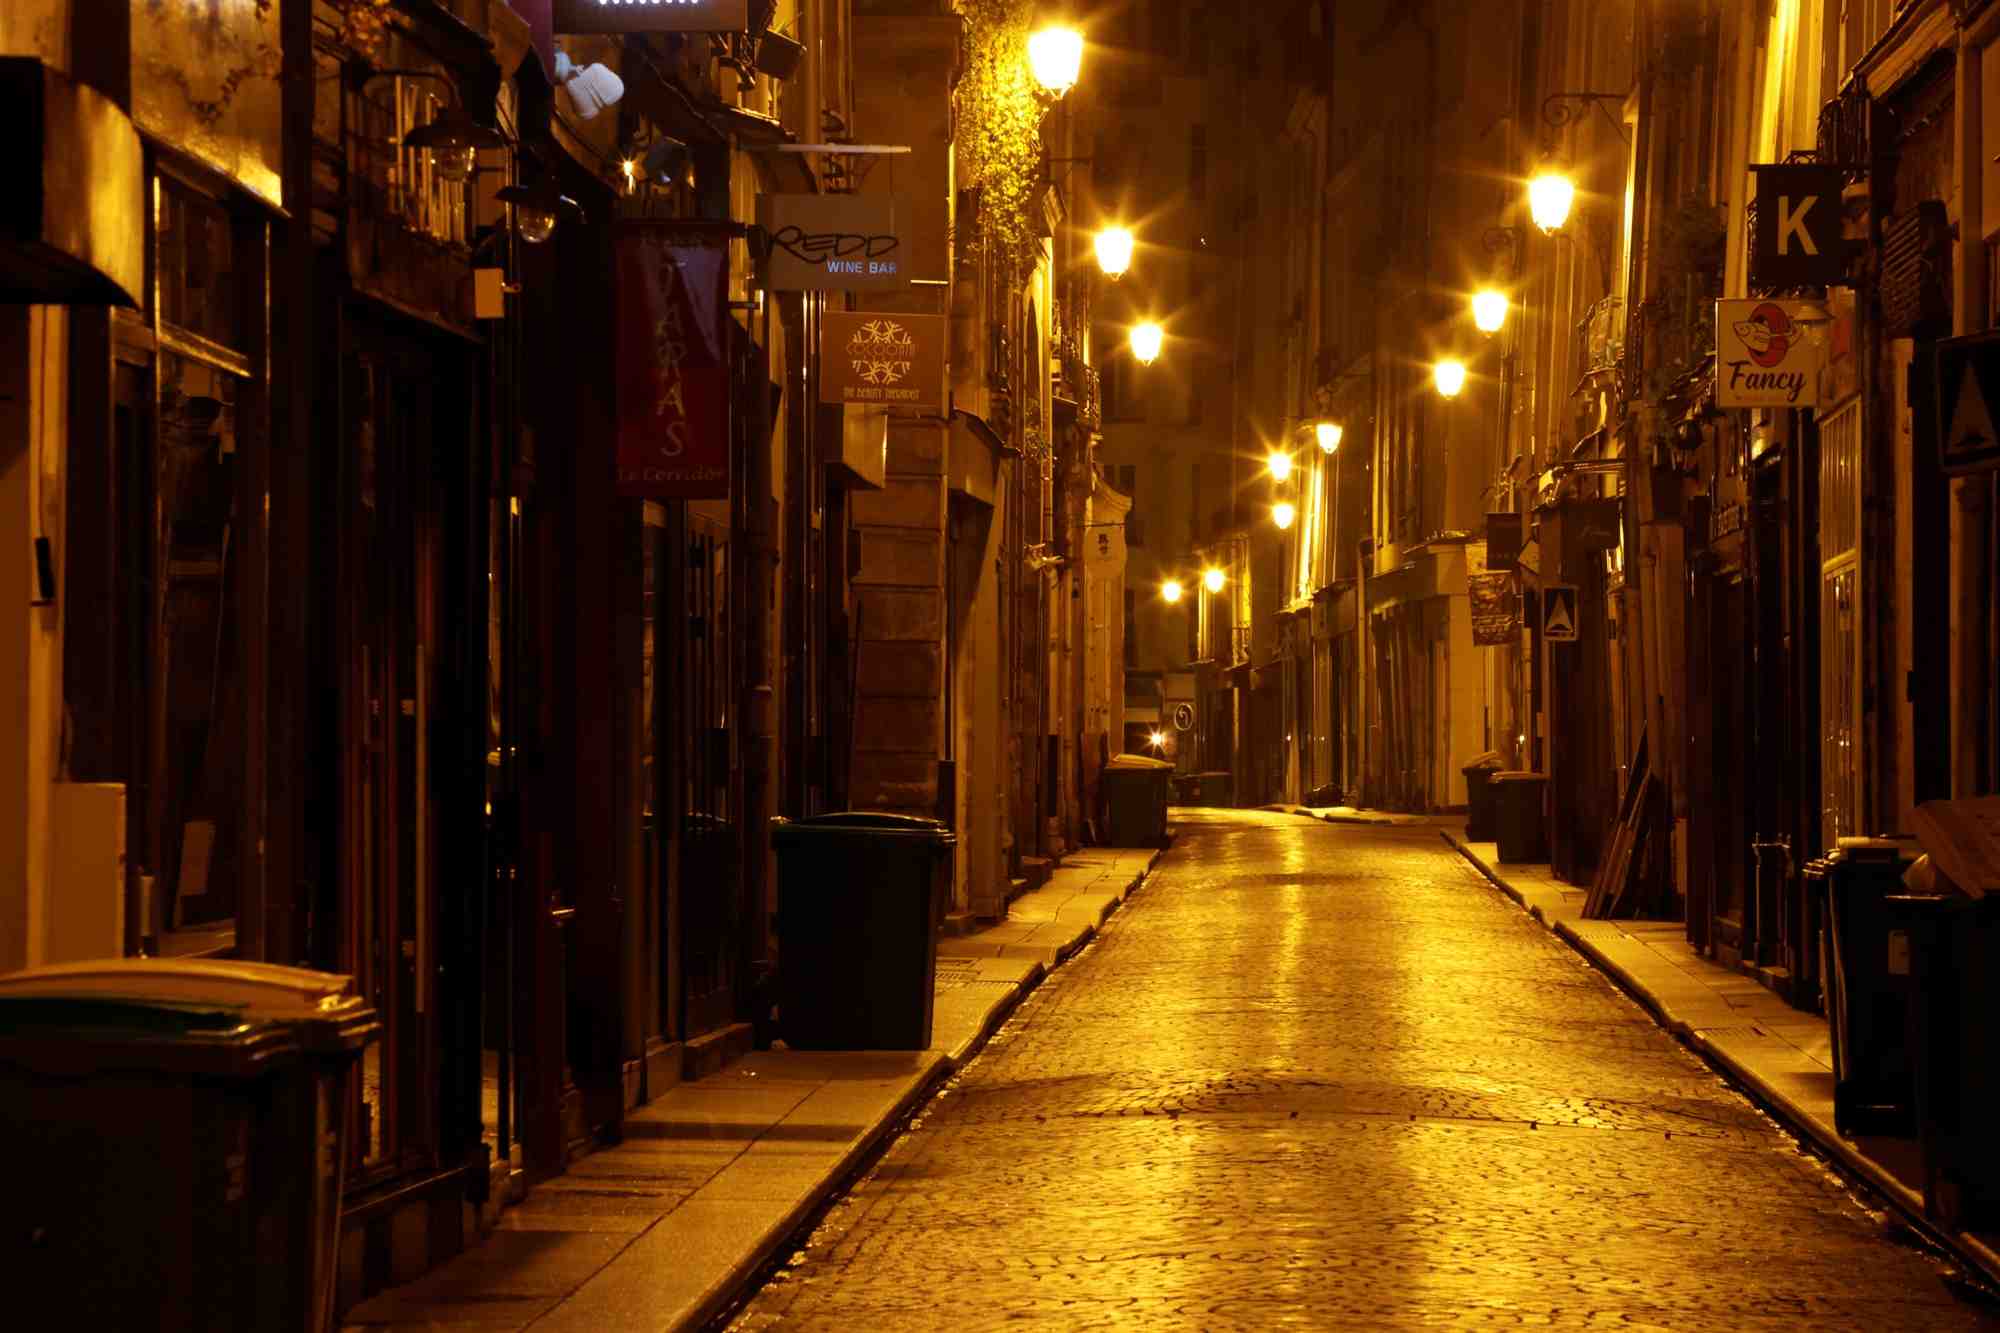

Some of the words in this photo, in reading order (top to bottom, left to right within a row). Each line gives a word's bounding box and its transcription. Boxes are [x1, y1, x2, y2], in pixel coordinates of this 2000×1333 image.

[772, 226, 899, 264] REDD
[1777, 196, 1819, 255] K
[827, 261, 864, 273] WINE
[869, 261, 897, 273] BAR
[1727, 360, 1807, 402] Fancy
